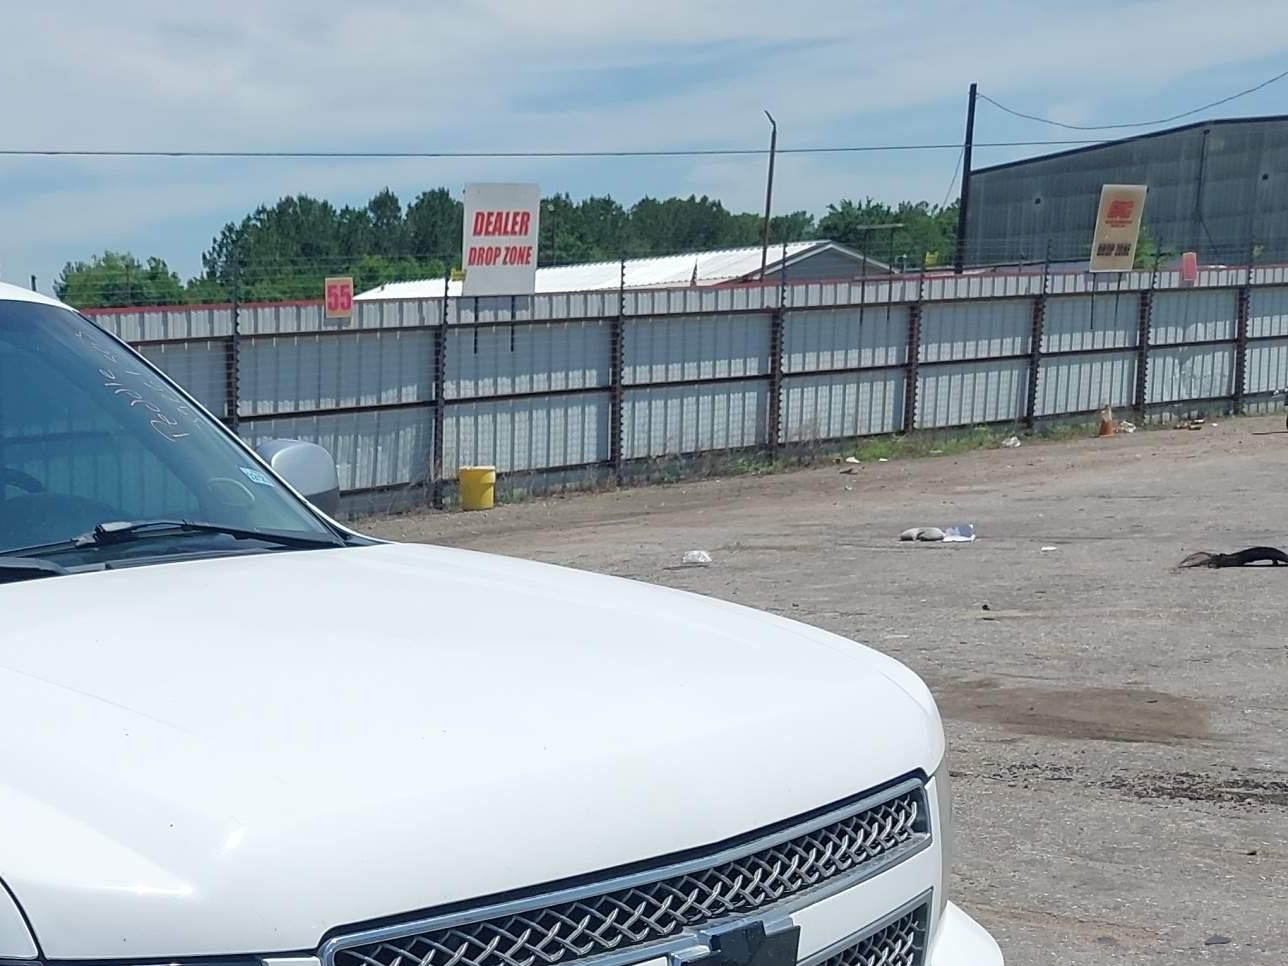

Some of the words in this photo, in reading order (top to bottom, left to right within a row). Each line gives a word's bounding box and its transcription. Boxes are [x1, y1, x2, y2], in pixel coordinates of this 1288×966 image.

[472, 210, 530, 237] DEALER
[468, 246, 501, 266] DROP
[502, 245, 533, 265] ZONE
[327, 284, 352, 311] 55
